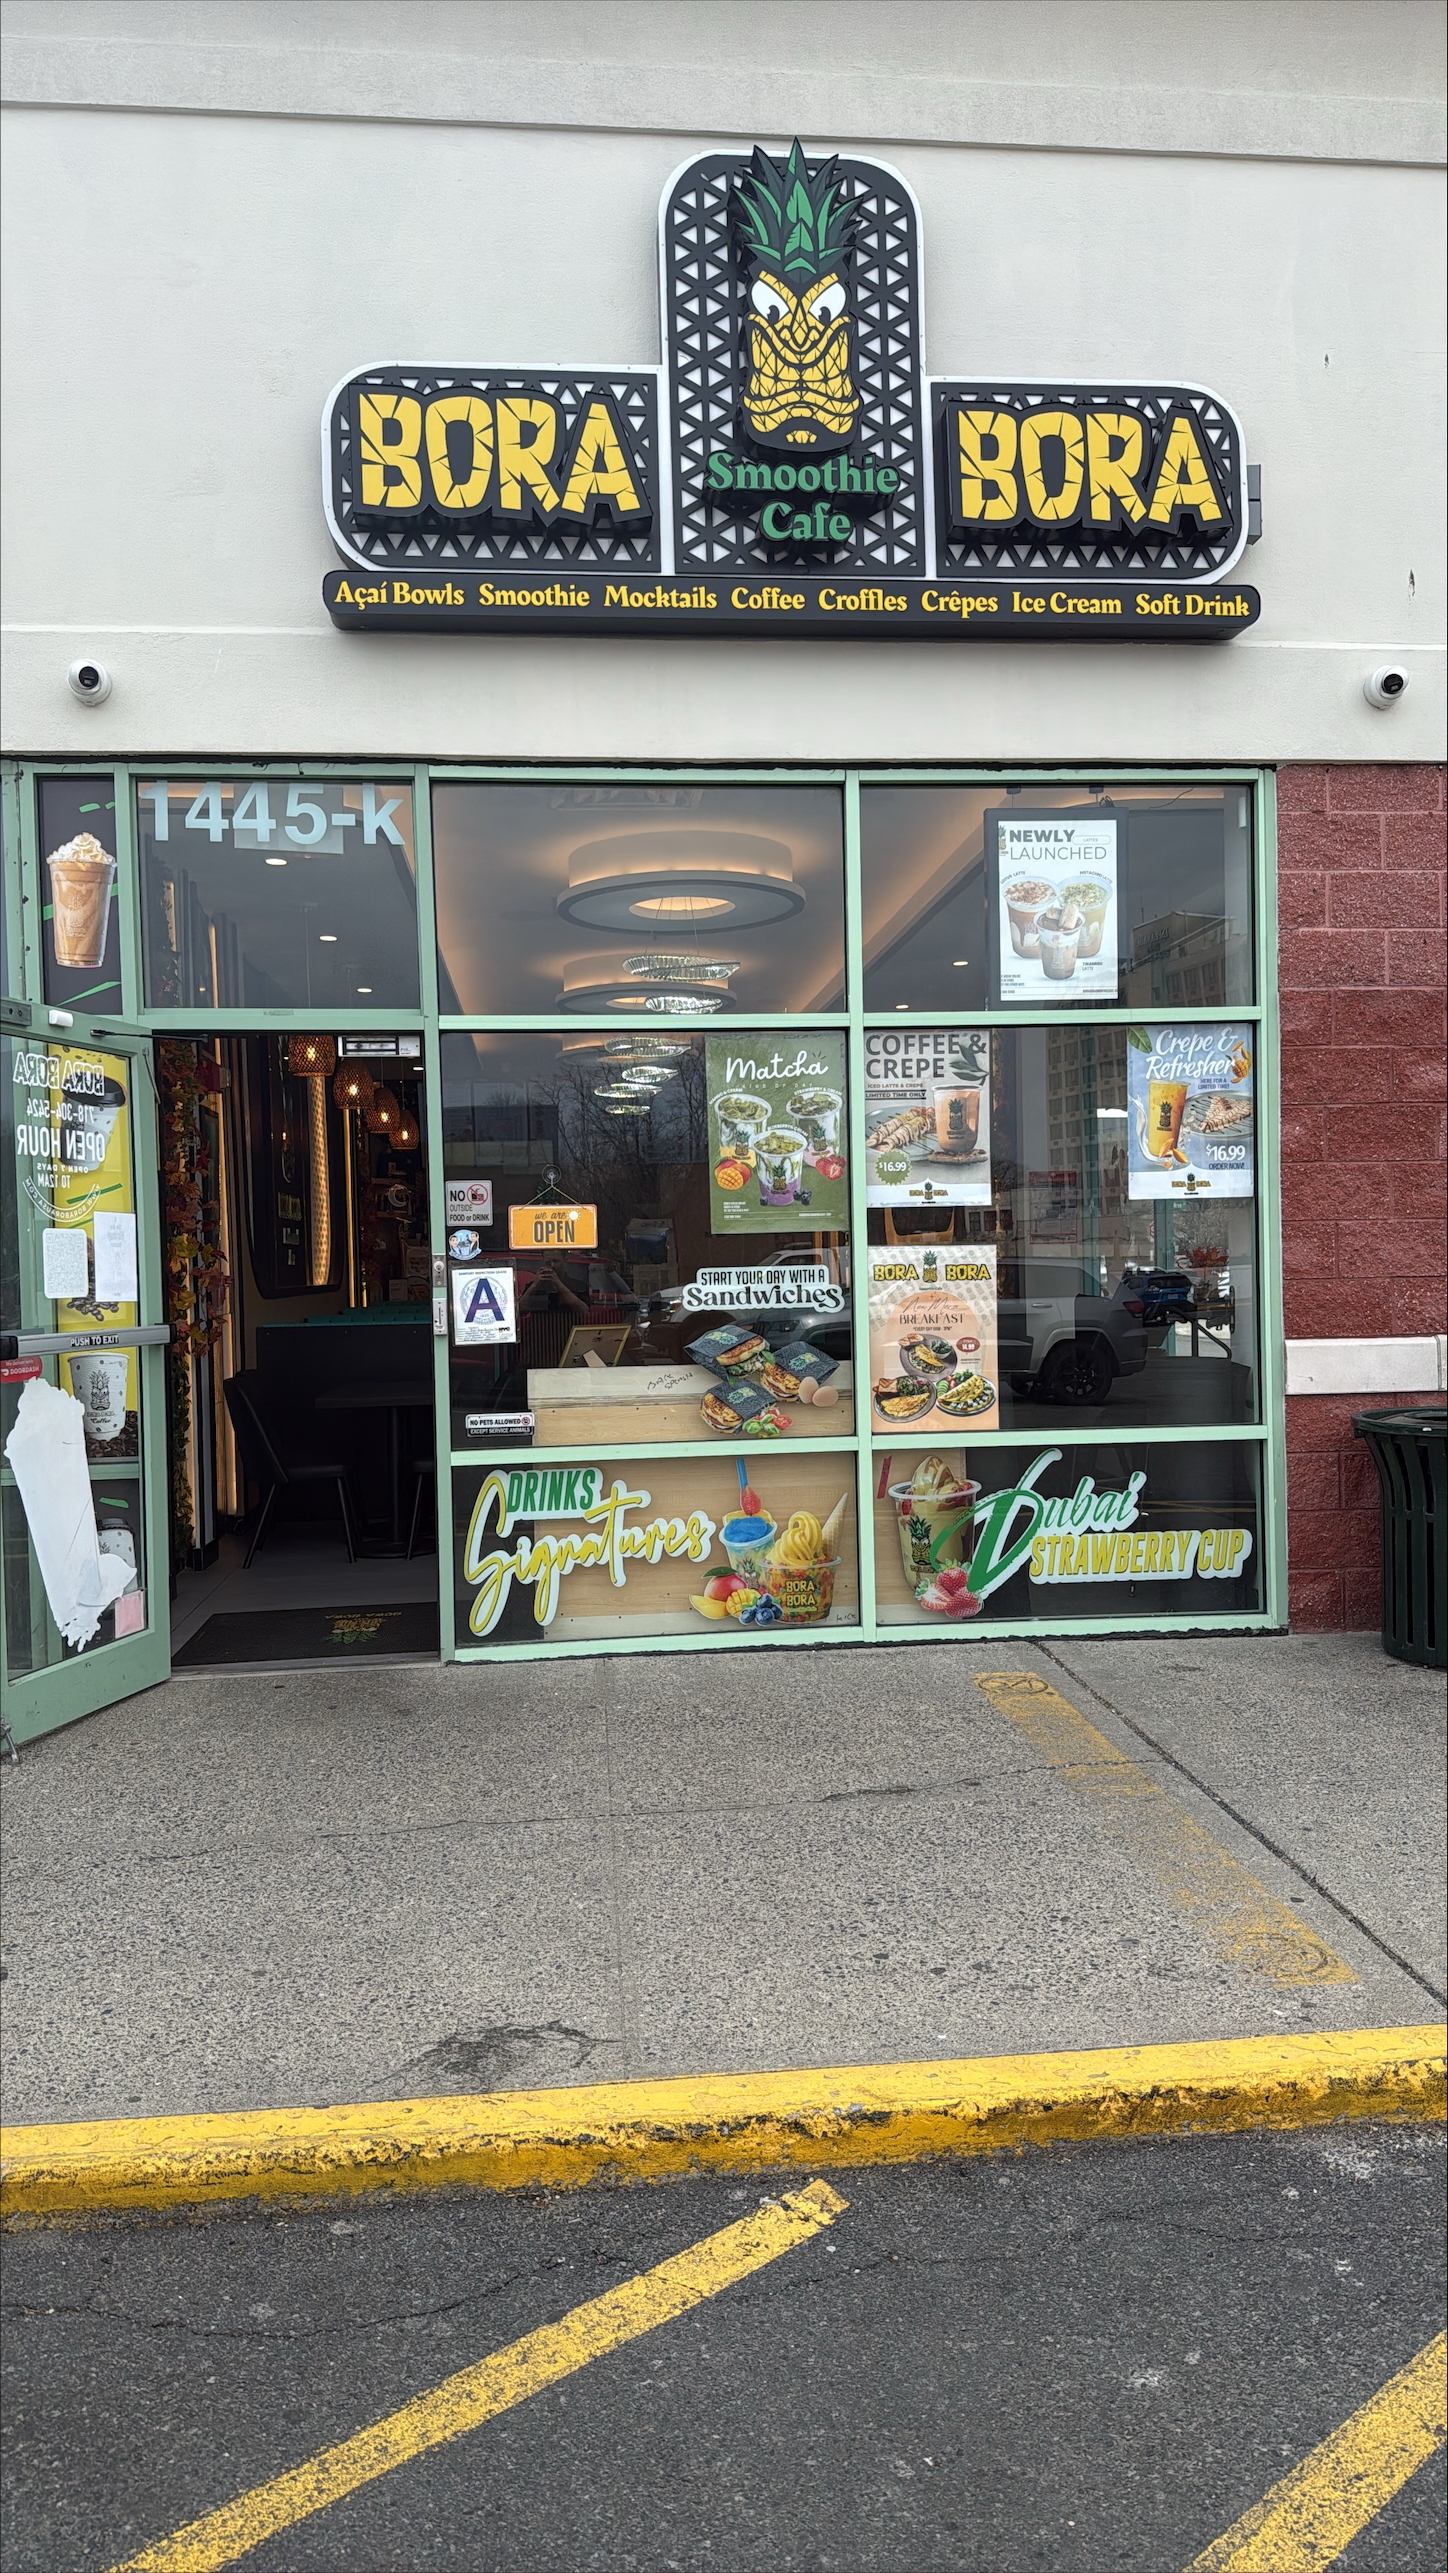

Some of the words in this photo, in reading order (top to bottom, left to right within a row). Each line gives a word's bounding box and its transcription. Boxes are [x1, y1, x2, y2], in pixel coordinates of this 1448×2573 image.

[358, 392, 644, 517] BORA
[706, 451, 898, 495] Smoothie
[958, 409, 1224, 526] BORA
[761, 500, 853, 543] Cafe
[335, 580, 387, 610] Açaí
[393, 581, 465, 606] Bowls
[479, 583, 591, 607] Smoothie
[604, 584, 718, 609] Mocktails
[730, 586, 805, 610] Coffee
[818, 588, 908, 612] Croffles
[921, 589, 999, 619] Crêpes
[1012, 591, 1046, 614] Ice
[1049, 591, 1123, 614] Cream
[1135, 594, 1180, 616] Soft
[1185, 594, 1250, 617] Drink
[1009, 830, 1075, 842] NEWLY
[1010, 847, 1107, 860] LAUNCHED
[866, 1034, 960, 1056] COFFEE
[969, 1033, 987, 1053] &
[1156, 1029, 1213, 1061] Crepe
[1217, 1027, 1238, 1052] &
[725, 1050, 829, 1083] Matcha
[866, 1058, 945, 1079] CREPE
[1145, 1051, 1235, 1080] Refresher
[1206, 1143, 1246, 1161] $16.99
[879, 1161, 907, 1172] $16.99
[1208, 1162, 1229, 1170] ORDER
[1228, 1162, 1245, 1170] NOW!
[450, 1190, 466, 1201] NO
[450, 1204, 473, 1212] OUTSIDE
[450, 1213, 466, 1222] FOOD
[472, 1213, 490, 1221] DRINK
[534, 1212, 547, 1220] we
[533, 1220, 575, 1244] OPEN
[701, 1271, 732, 1286] START
[735, 1271, 763, 1285] YOUR
[766, 1270, 786, 1285] DAY
[789, 1269, 815, 1284] WITH
[818, 1269, 825, 1283] A
[873, 1264, 919, 1281] BORA
[945, 1264, 991, 1282] BORA
[464, 1278, 505, 1323] A
[686, 1285, 841, 1309] Sandwiches
[900, 1313, 965, 1324] BREAKFAST
[70, 1338, 90, 1347] PUSH
[91, 1337, 101, 1345] TO
[103, 1335, 119, 1344] EXIT
[10, 1366, 39, 1375] DOORDASH
[506, 1467, 597, 1514] DRINKS
[930, 1448, 1142, 1592] Dubai
[464, 1474, 708, 1634] Signatures
[1029, 1531, 1192, 1577] STRAWBERRY
[1196, 1530, 1245, 1571] CUP
[786, 1580, 815, 1592] BORA
[786, 1594, 816, 1606] BORA
